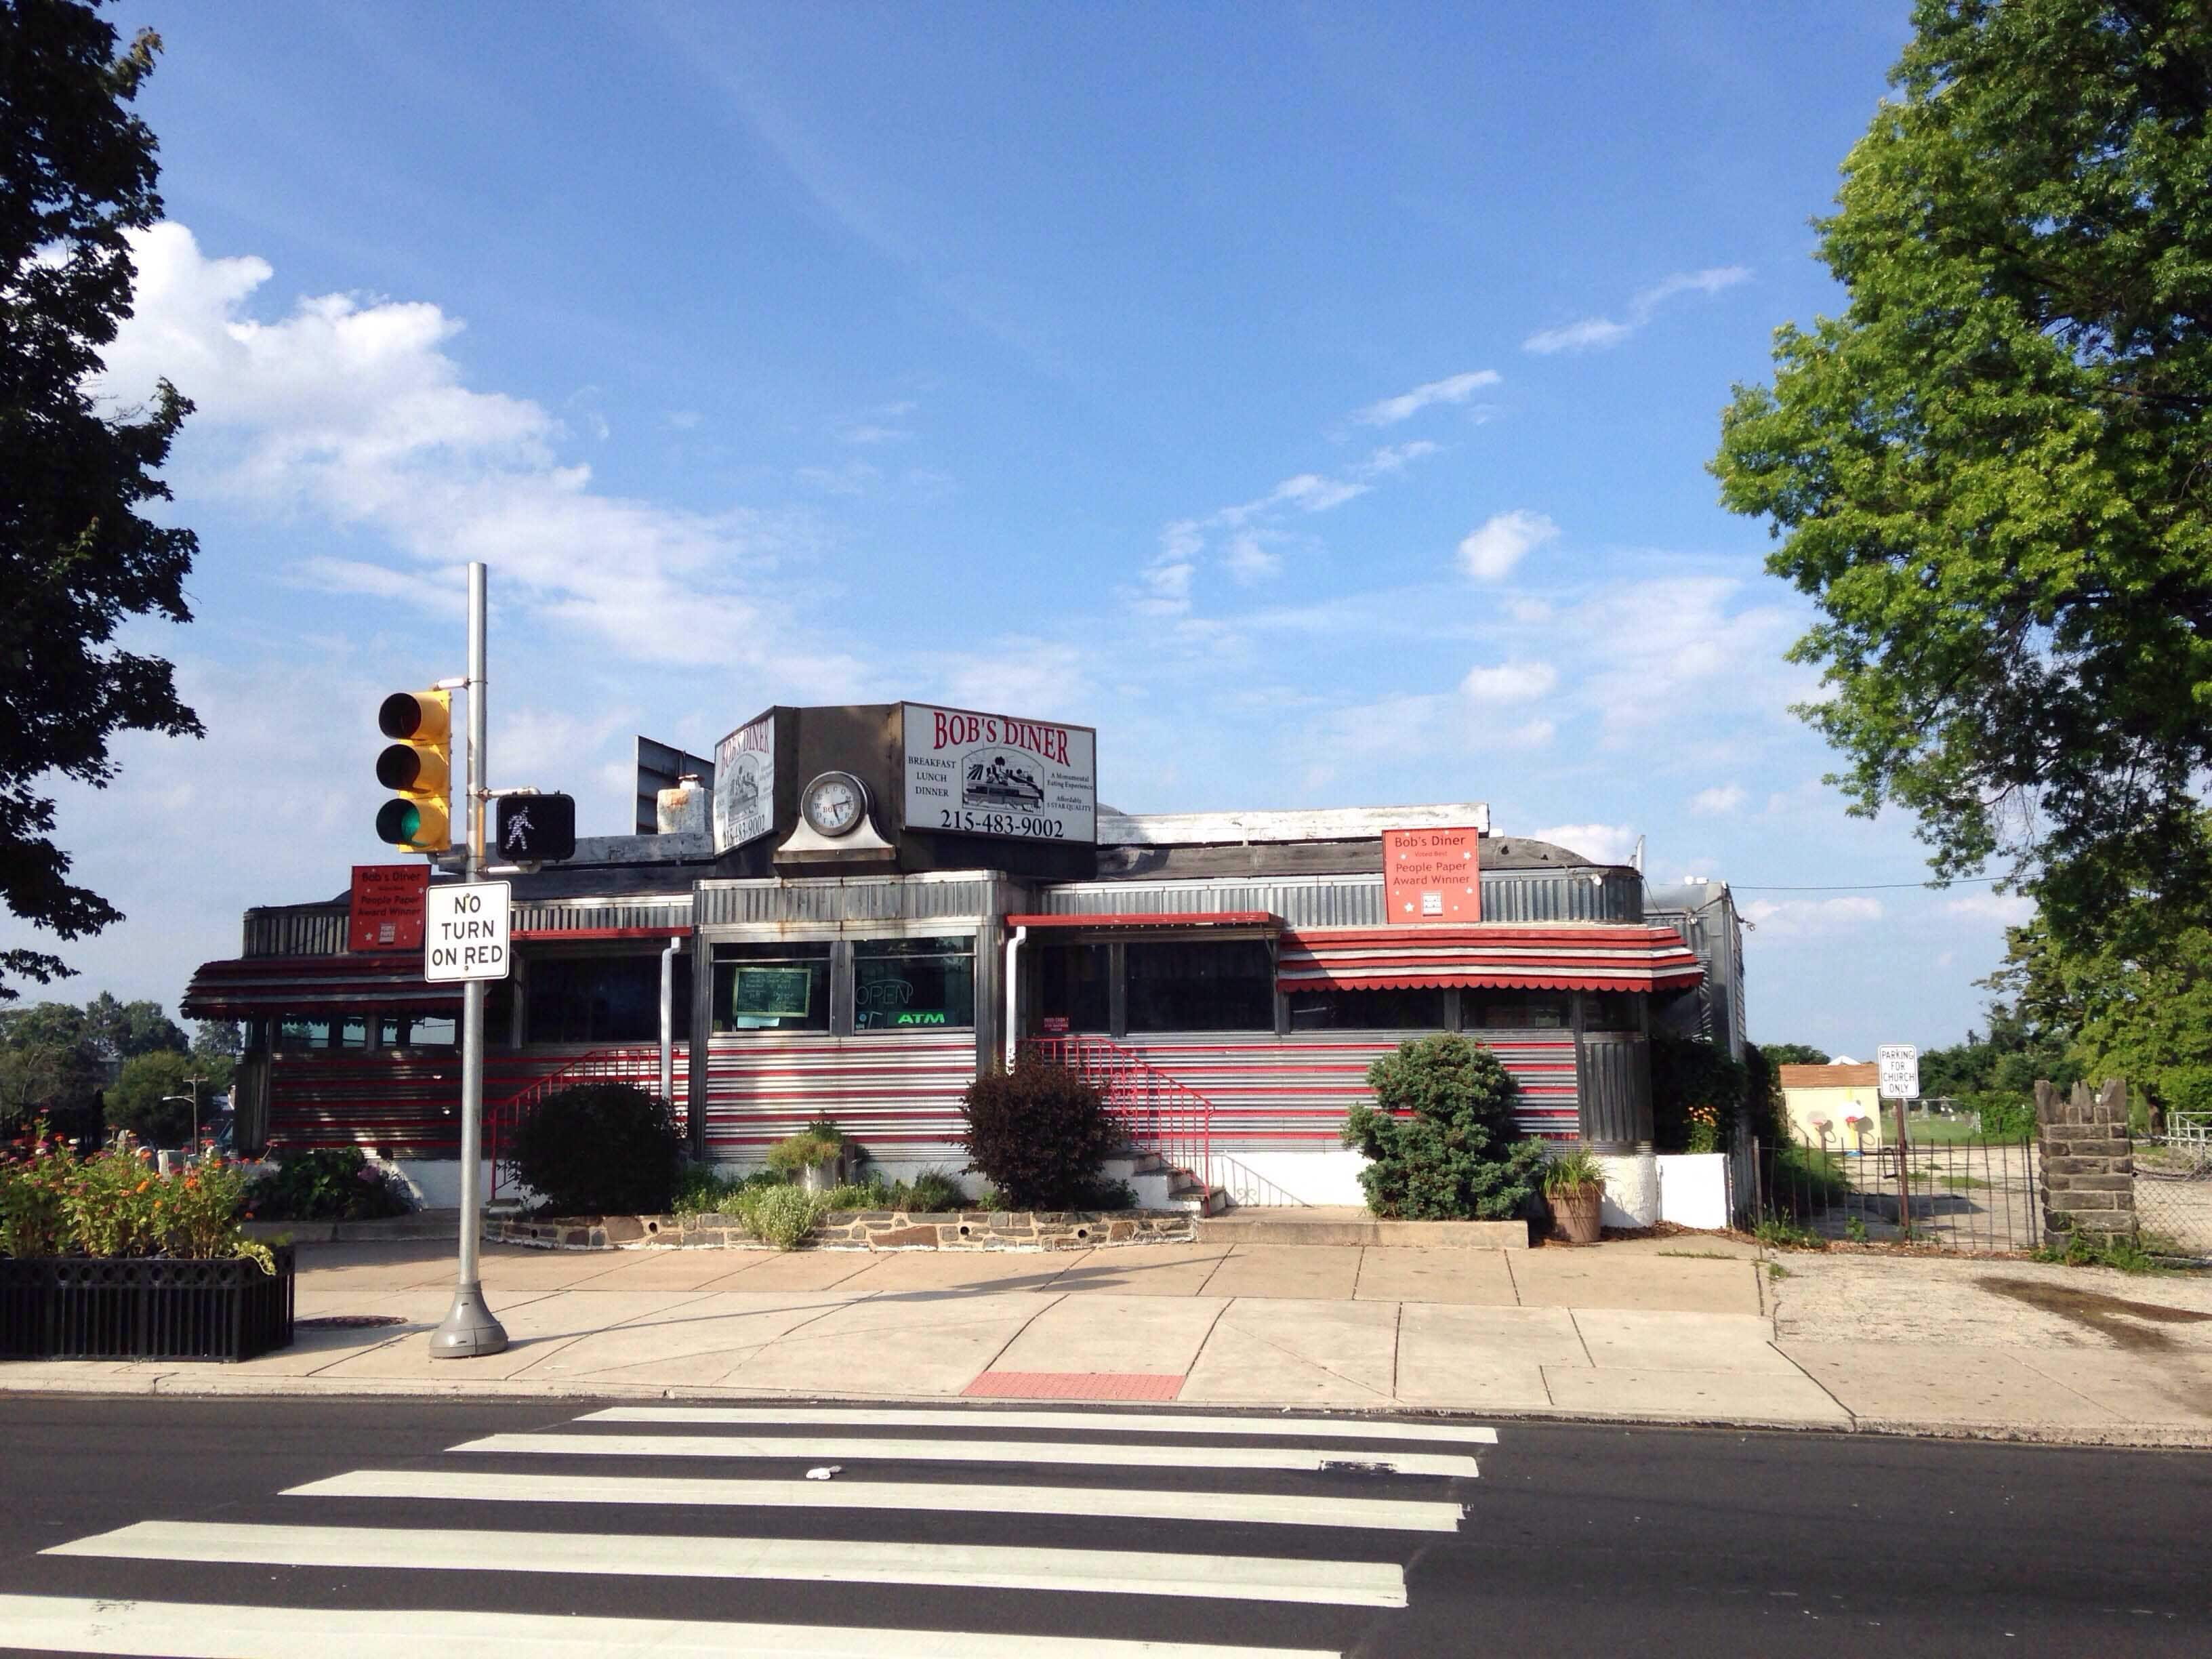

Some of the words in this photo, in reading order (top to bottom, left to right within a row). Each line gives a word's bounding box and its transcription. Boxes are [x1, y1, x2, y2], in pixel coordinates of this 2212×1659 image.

[743, 719, 770, 754] DINER
[933, 712, 997, 750] BOB'S
[1003, 720, 1071, 767] DINER
[908, 756, 956, 769] BREAKFAST
[916, 771, 947, 782] LUNCH
[1057, 773, 1089, 782] Monumental
[1047, 779, 1064, 789] Eating
[1065, 781, 1093, 791] Experience
[916, 786, 949, 798] DINNER
[1066, 803, 1092, 813] QUALITY
[941, 808, 1064, 838] 215-483-9002
[723, 815, 765, 848] 215-483-9002
[1395, 836, 1427, 847] Bob's
[1432, 836, 1466, 846] Diner
[1396, 862, 1432, 875] People
[1437, 861, 1467, 873] Paper
[362, 872, 389, 882] Bob's
[393, 872, 422, 882] Diner
[1393, 875, 1427, 886] Award
[1431, 874, 1469, 884] Winner
[362, 895, 391, 906] People
[394, 895, 420, 905] Paper
[455, 895, 481, 914] NO
[358, 908, 386, 916] Award
[390, 907, 422, 916] Winner
[441, 920, 494, 941] TURN
[432, 947, 457, 966] ON
[465, 945, 503, 965] RED
[856, 985, 909, 1004] OPEN
[897, 1013, 945, 1024] ATM
[1882, 1050, 1914, 1059] PARKING
[1891, 1061, 1906, 1071] FOR
[1883, 1073, 1914, 1082] CHURCH
[1889, 1084, 1908, 1093] ONLY
